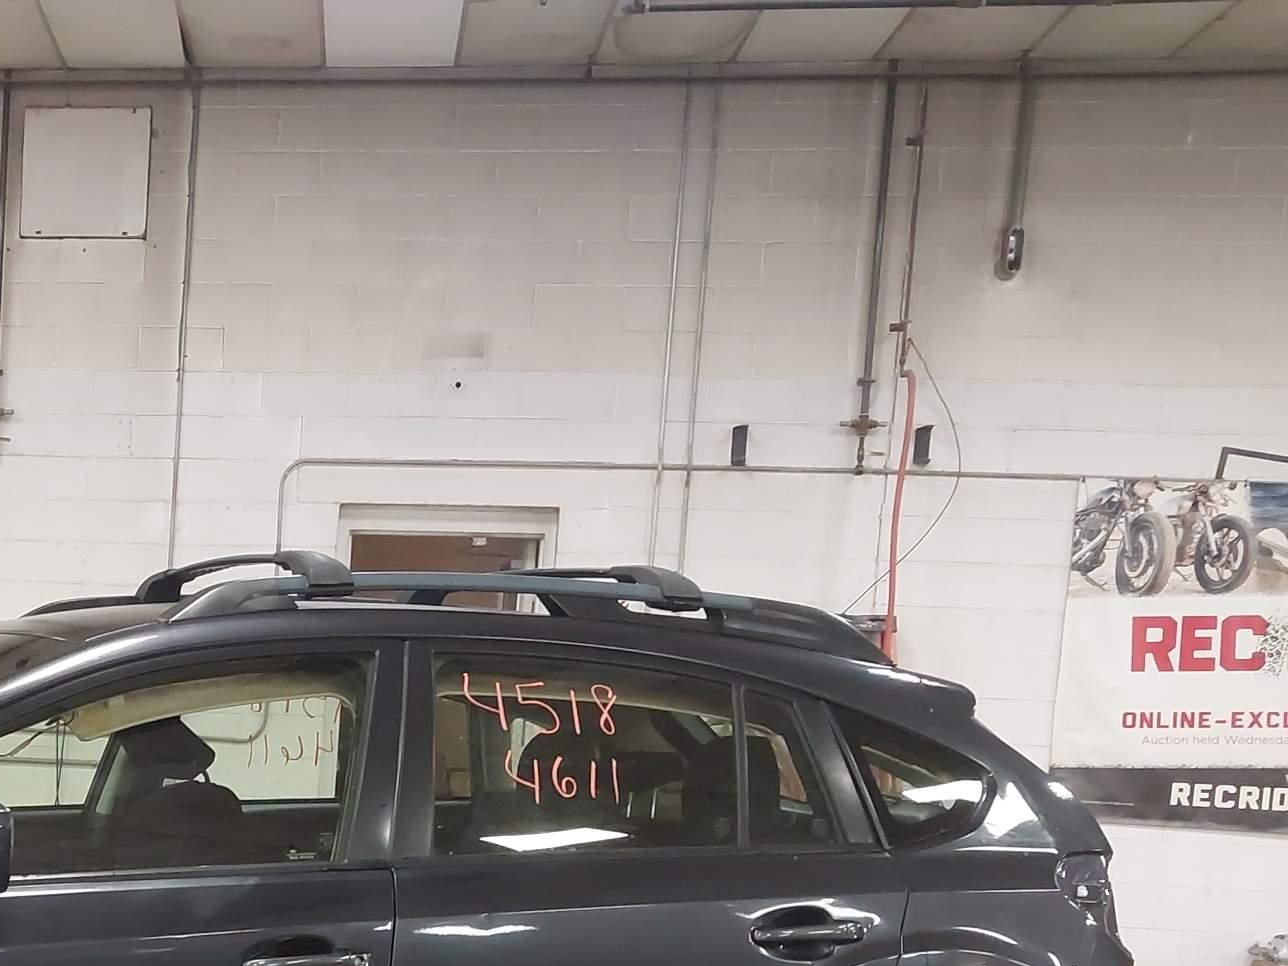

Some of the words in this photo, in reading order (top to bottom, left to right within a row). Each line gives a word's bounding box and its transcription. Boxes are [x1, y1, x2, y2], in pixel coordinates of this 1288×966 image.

[462, 672, 617, 736] 4518
[1141, 735, 1189, 745] Auction
[1192, 735, 1220, 745] held
[504, 750, 620, 805] 4611
[1169, 782, 1288, 812] RECRID
